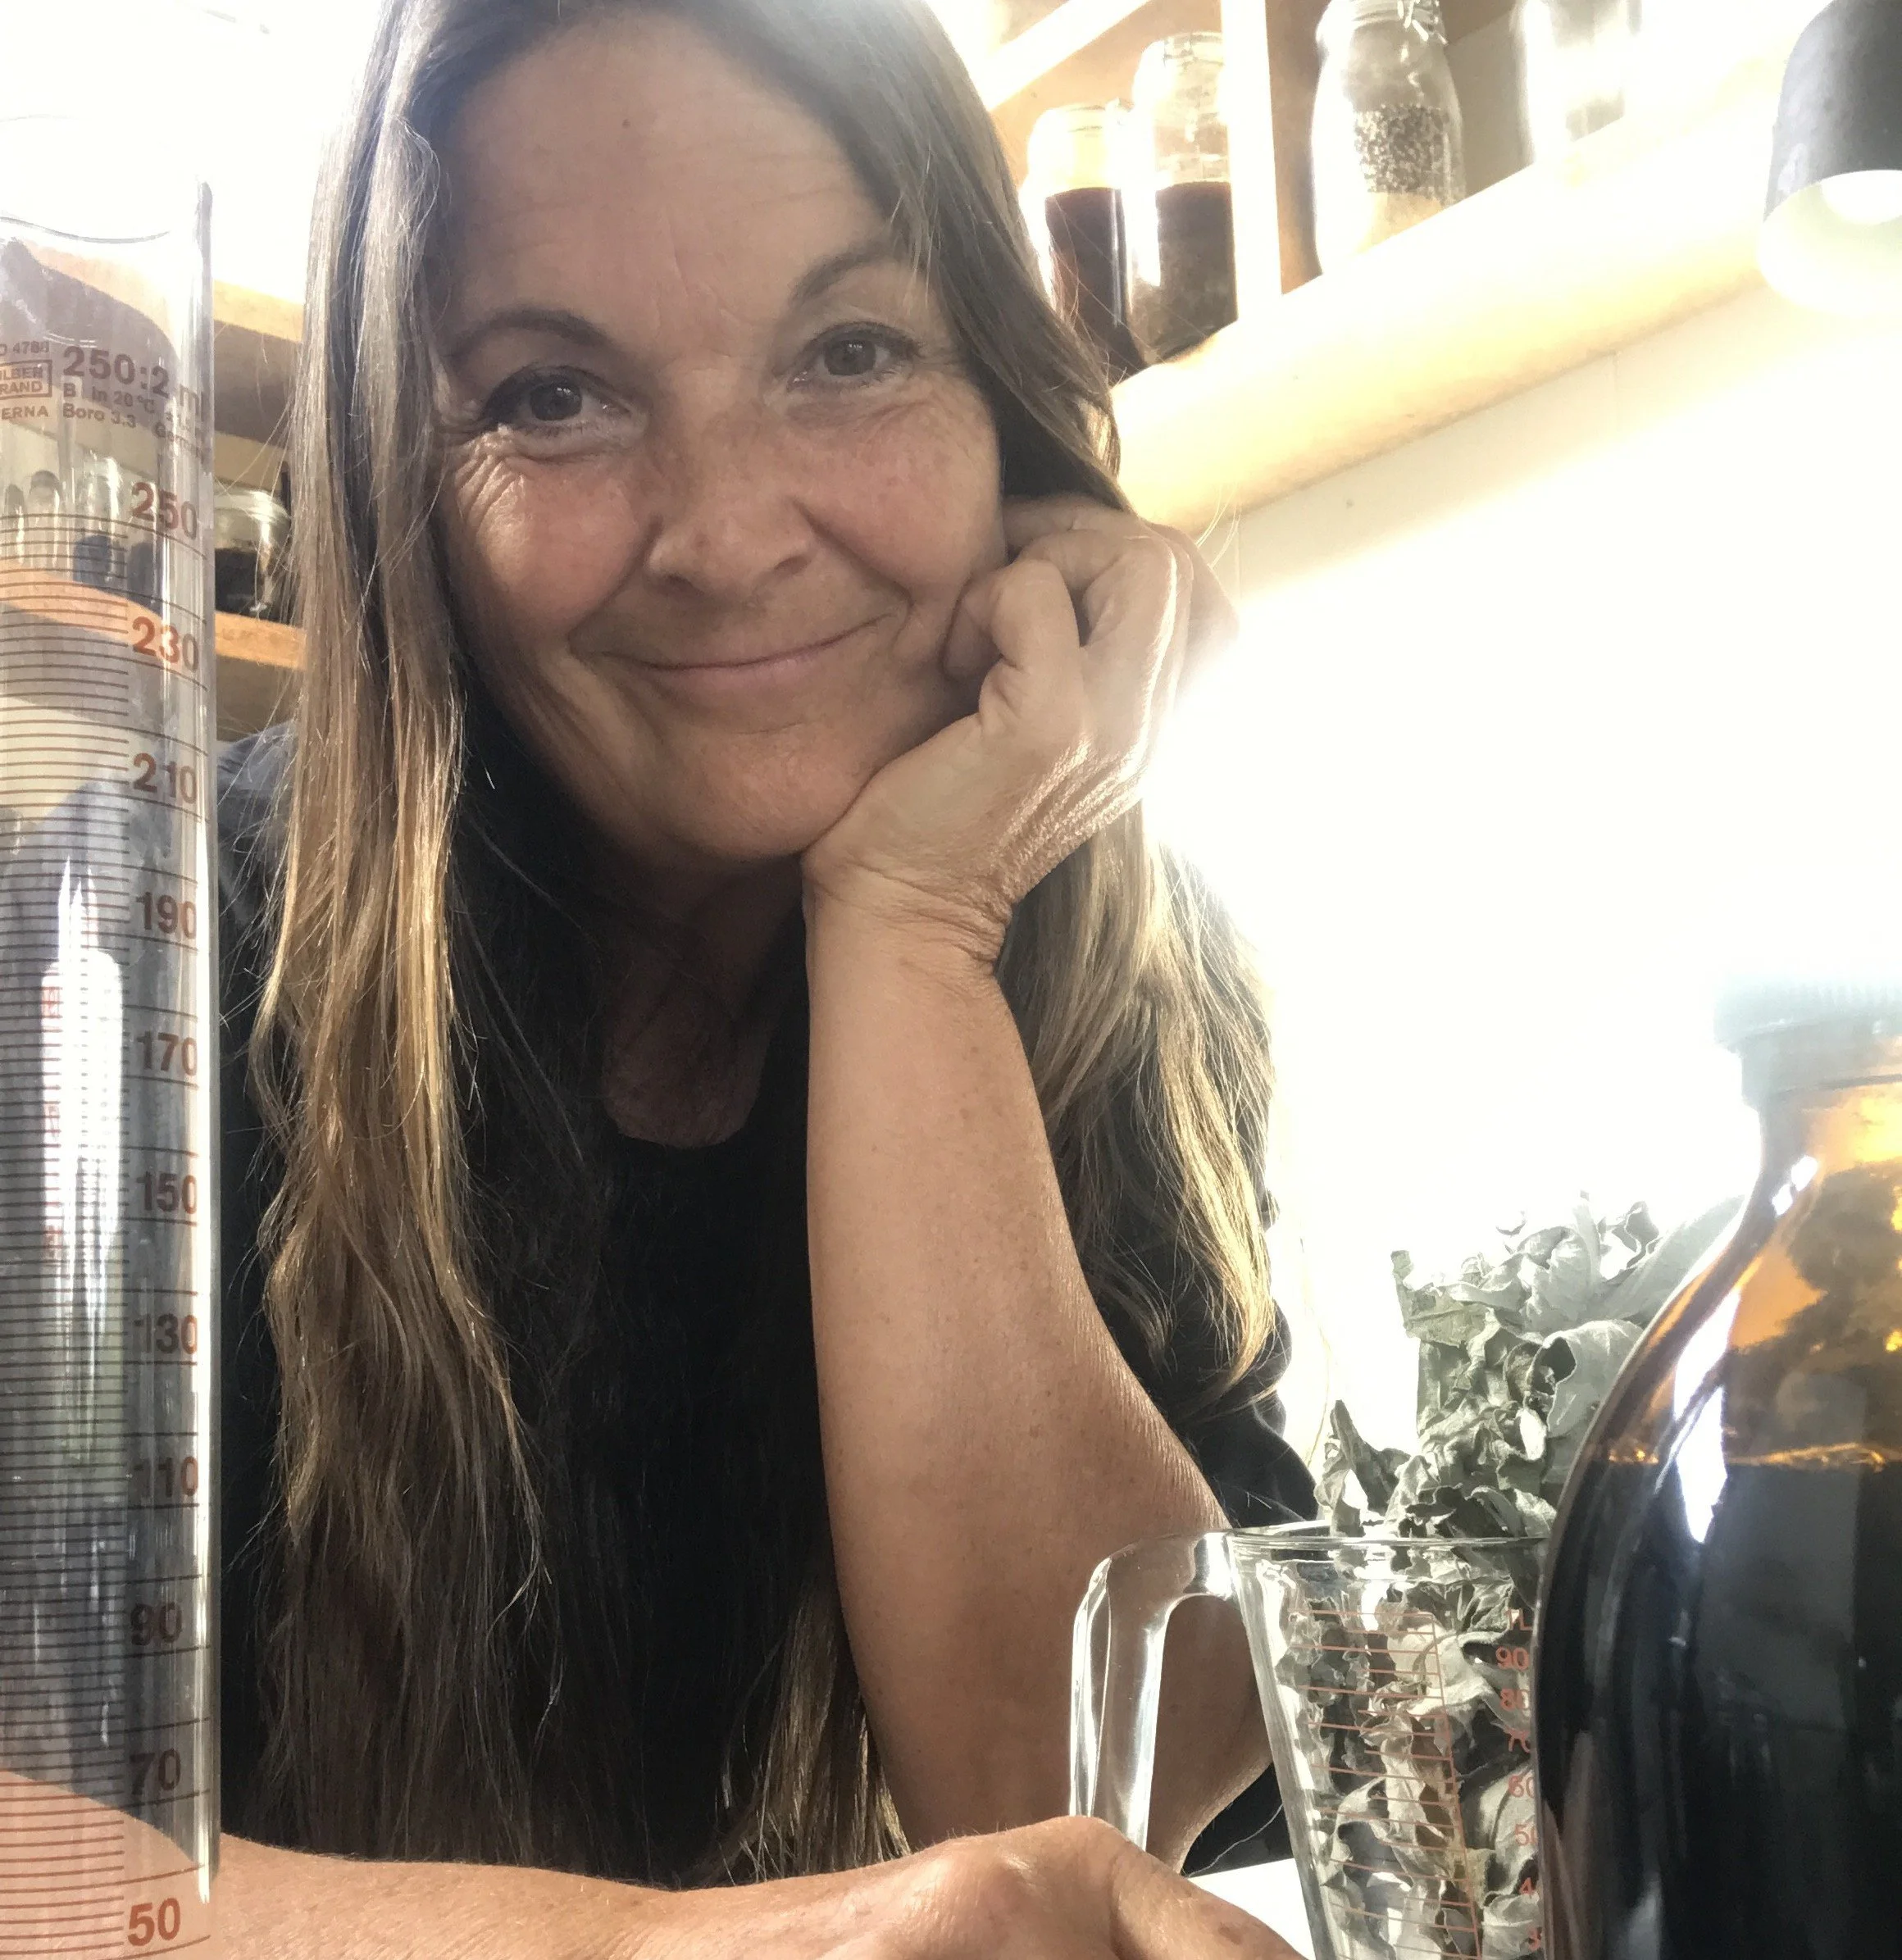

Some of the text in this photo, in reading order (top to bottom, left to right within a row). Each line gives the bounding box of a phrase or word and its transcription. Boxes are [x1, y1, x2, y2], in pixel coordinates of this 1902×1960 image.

[2, 406, 48, 420] ERNA
[63, 403, 105, 421] Boro
[132, 482, 197, 539] 250
[132, 616, 199, 674] 230
[133, 753, 198, 805] 210
[136, 891, 197, 940] 190
[137, 1030, 198, 1077] 170
[137, 1171, 197, 1215] 150
[133, 1312, 198, 1355] 130
[134, 1456, 198, 1499] 110
[130, 1602, 183, 1646] 90
[129, 1749, 182, 1795] 70
[127, 1897, 181, 1947] 50
